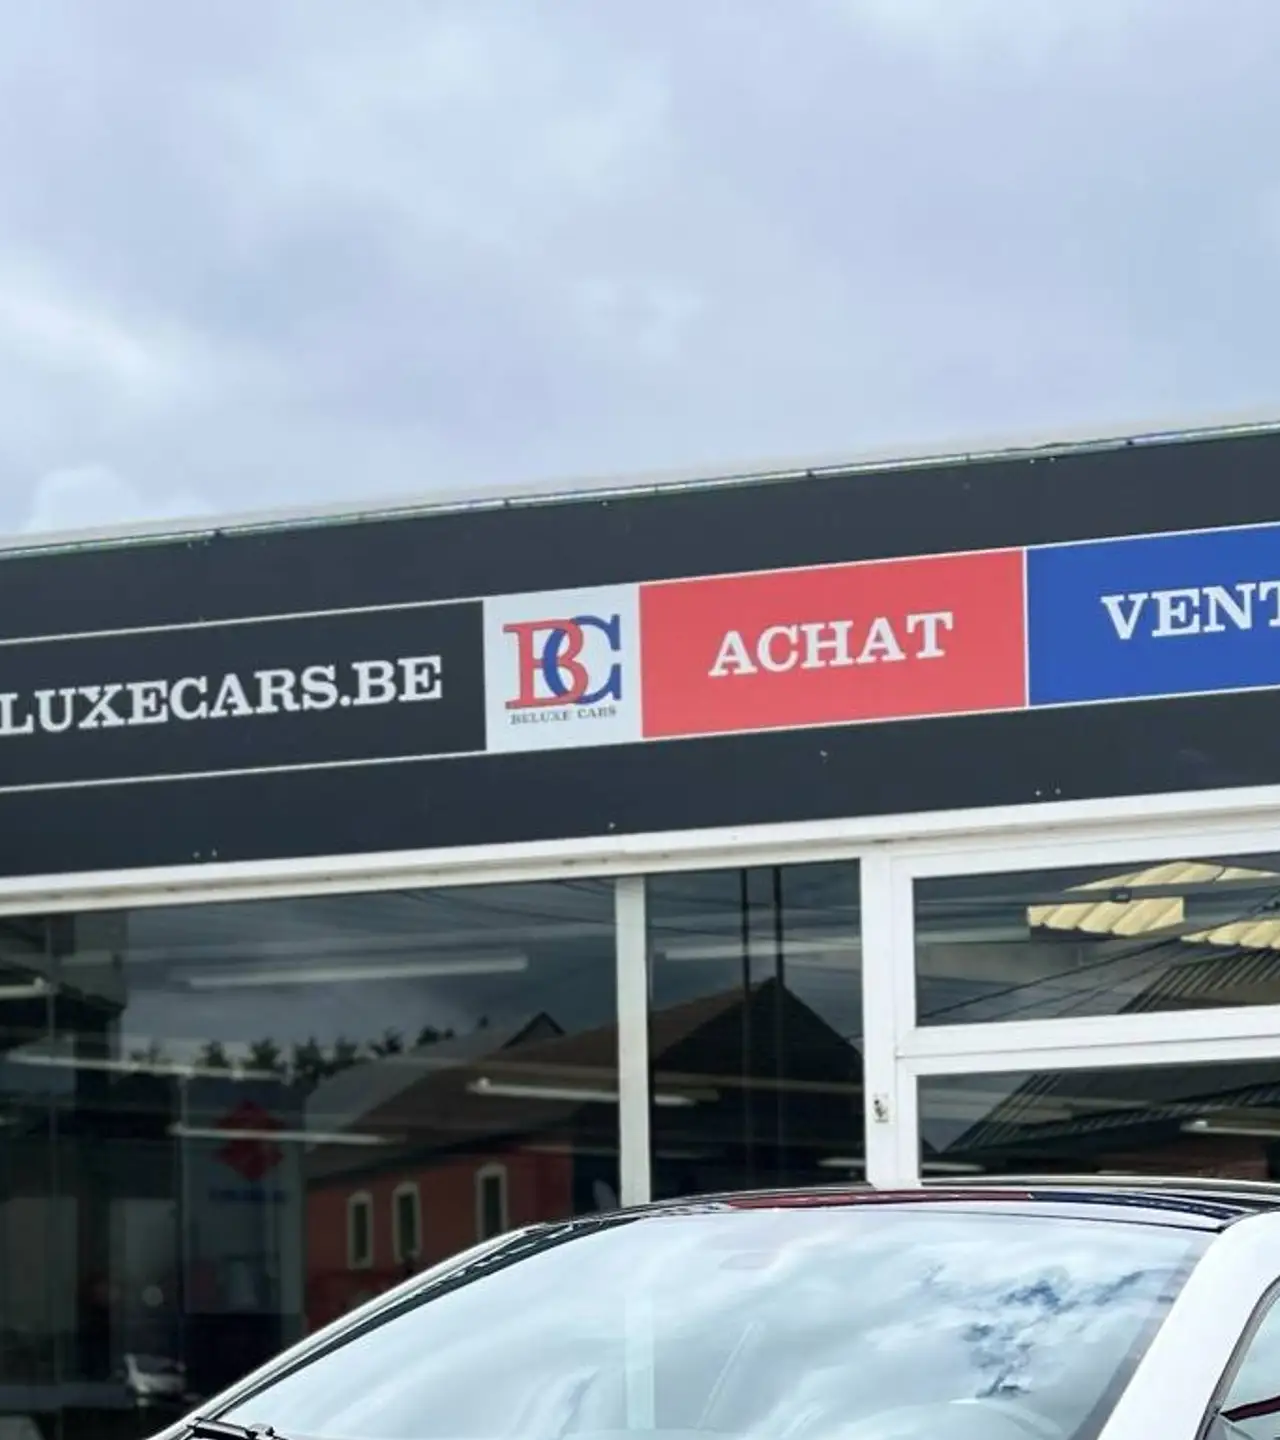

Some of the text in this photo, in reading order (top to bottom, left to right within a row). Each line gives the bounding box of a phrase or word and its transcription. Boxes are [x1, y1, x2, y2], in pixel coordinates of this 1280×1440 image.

[709, 611, 953, 677] ACHAT
[509, 705, 617, 725] BELUXE CARS
